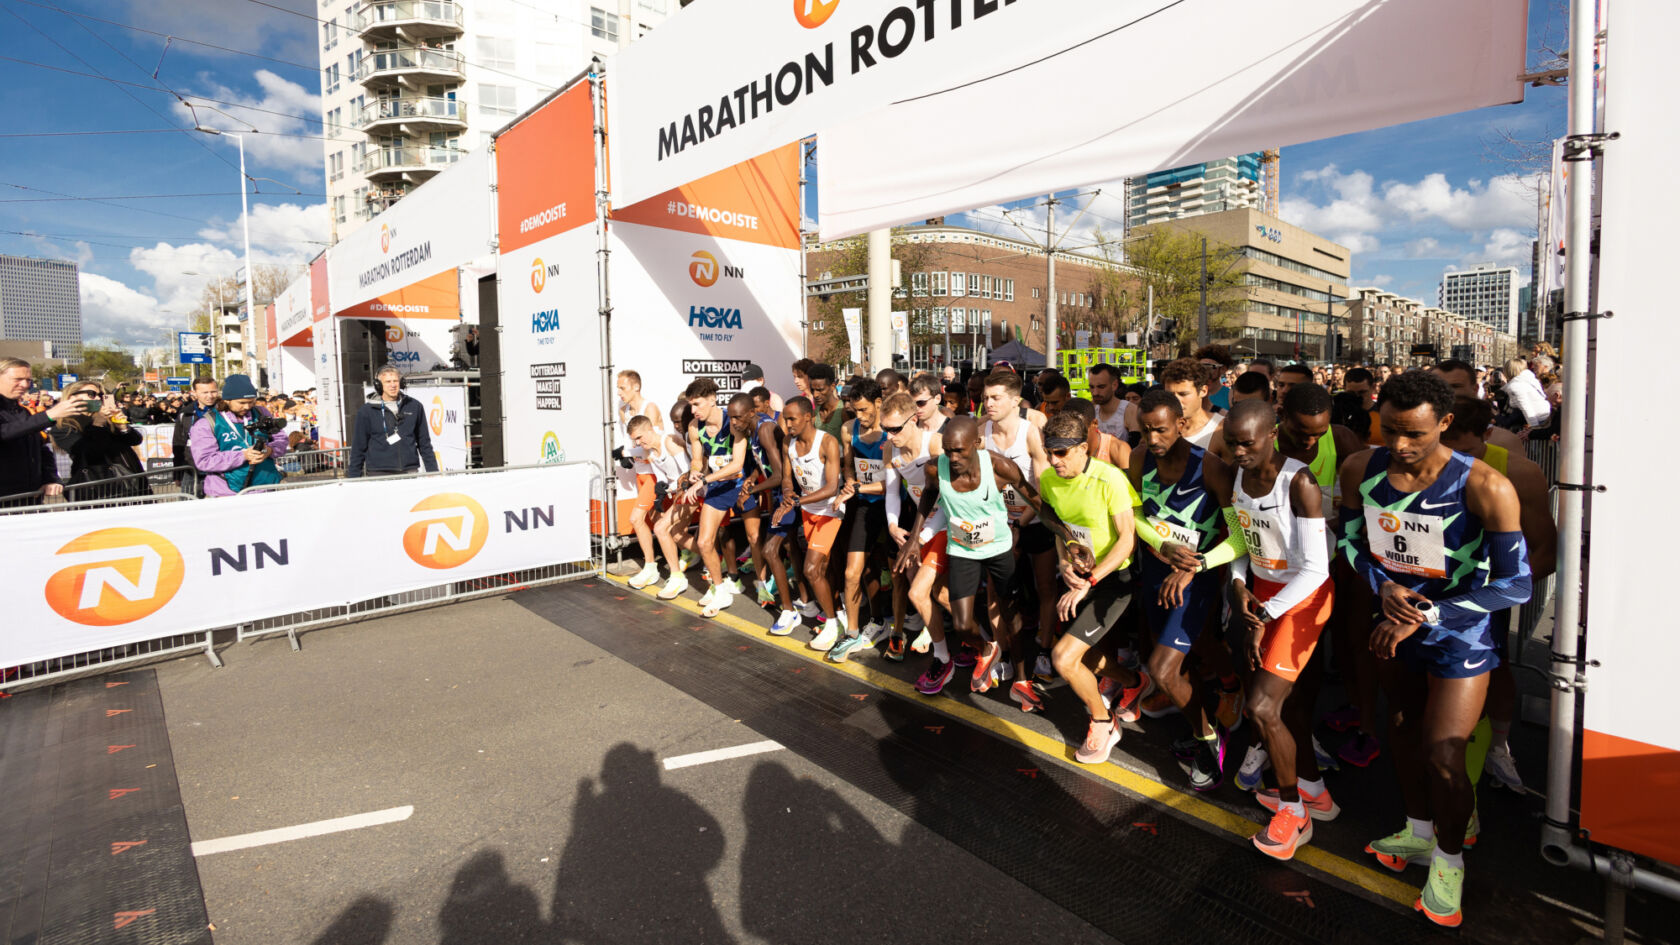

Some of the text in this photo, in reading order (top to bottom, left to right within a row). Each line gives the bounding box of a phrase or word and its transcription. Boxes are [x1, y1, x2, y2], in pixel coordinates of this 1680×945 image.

[657, 0, 1017, 162] MARATHON ROTT
[519, 202, 567, 234] #DEMOOISTE
[667, 201, 758, 230] #DEMOOISTE
[359, 239, 432, 289] MARATHON ROTTERDAM
[547, 264, 560, 278] NN
[724, 265, 744, 279] NN
[369, 303, 430, 313] #DEMOOISTE
[531, 309, 560, 334] HOKA
[688, 305, 743, 330] HOKA
[699, 333, 733, 342] TIME TO FLY
[538, 381, 560, 392] MAKE IT
[730, 378, 740, 388] IT
[445, 409, 457, 424] NN
[222, 432, 239, 442] 23
[863, 472, 873, 482] 14
[503, 504, 555, 534] NN
[975, 521, 989, 530] NN
[1252, 518, 1271, 529] NN
[1404, 520, 1430, 534] NN
[1072, 530, 1086, 539] NN
[1172, 531, 1190, 544] NN
[1244, 528, 1262, 548] 50
[1393, 534, 1407, 554] 6
[208, 538, 289, 577] NN
[1385, 549, 1420, 566] WOLDE
